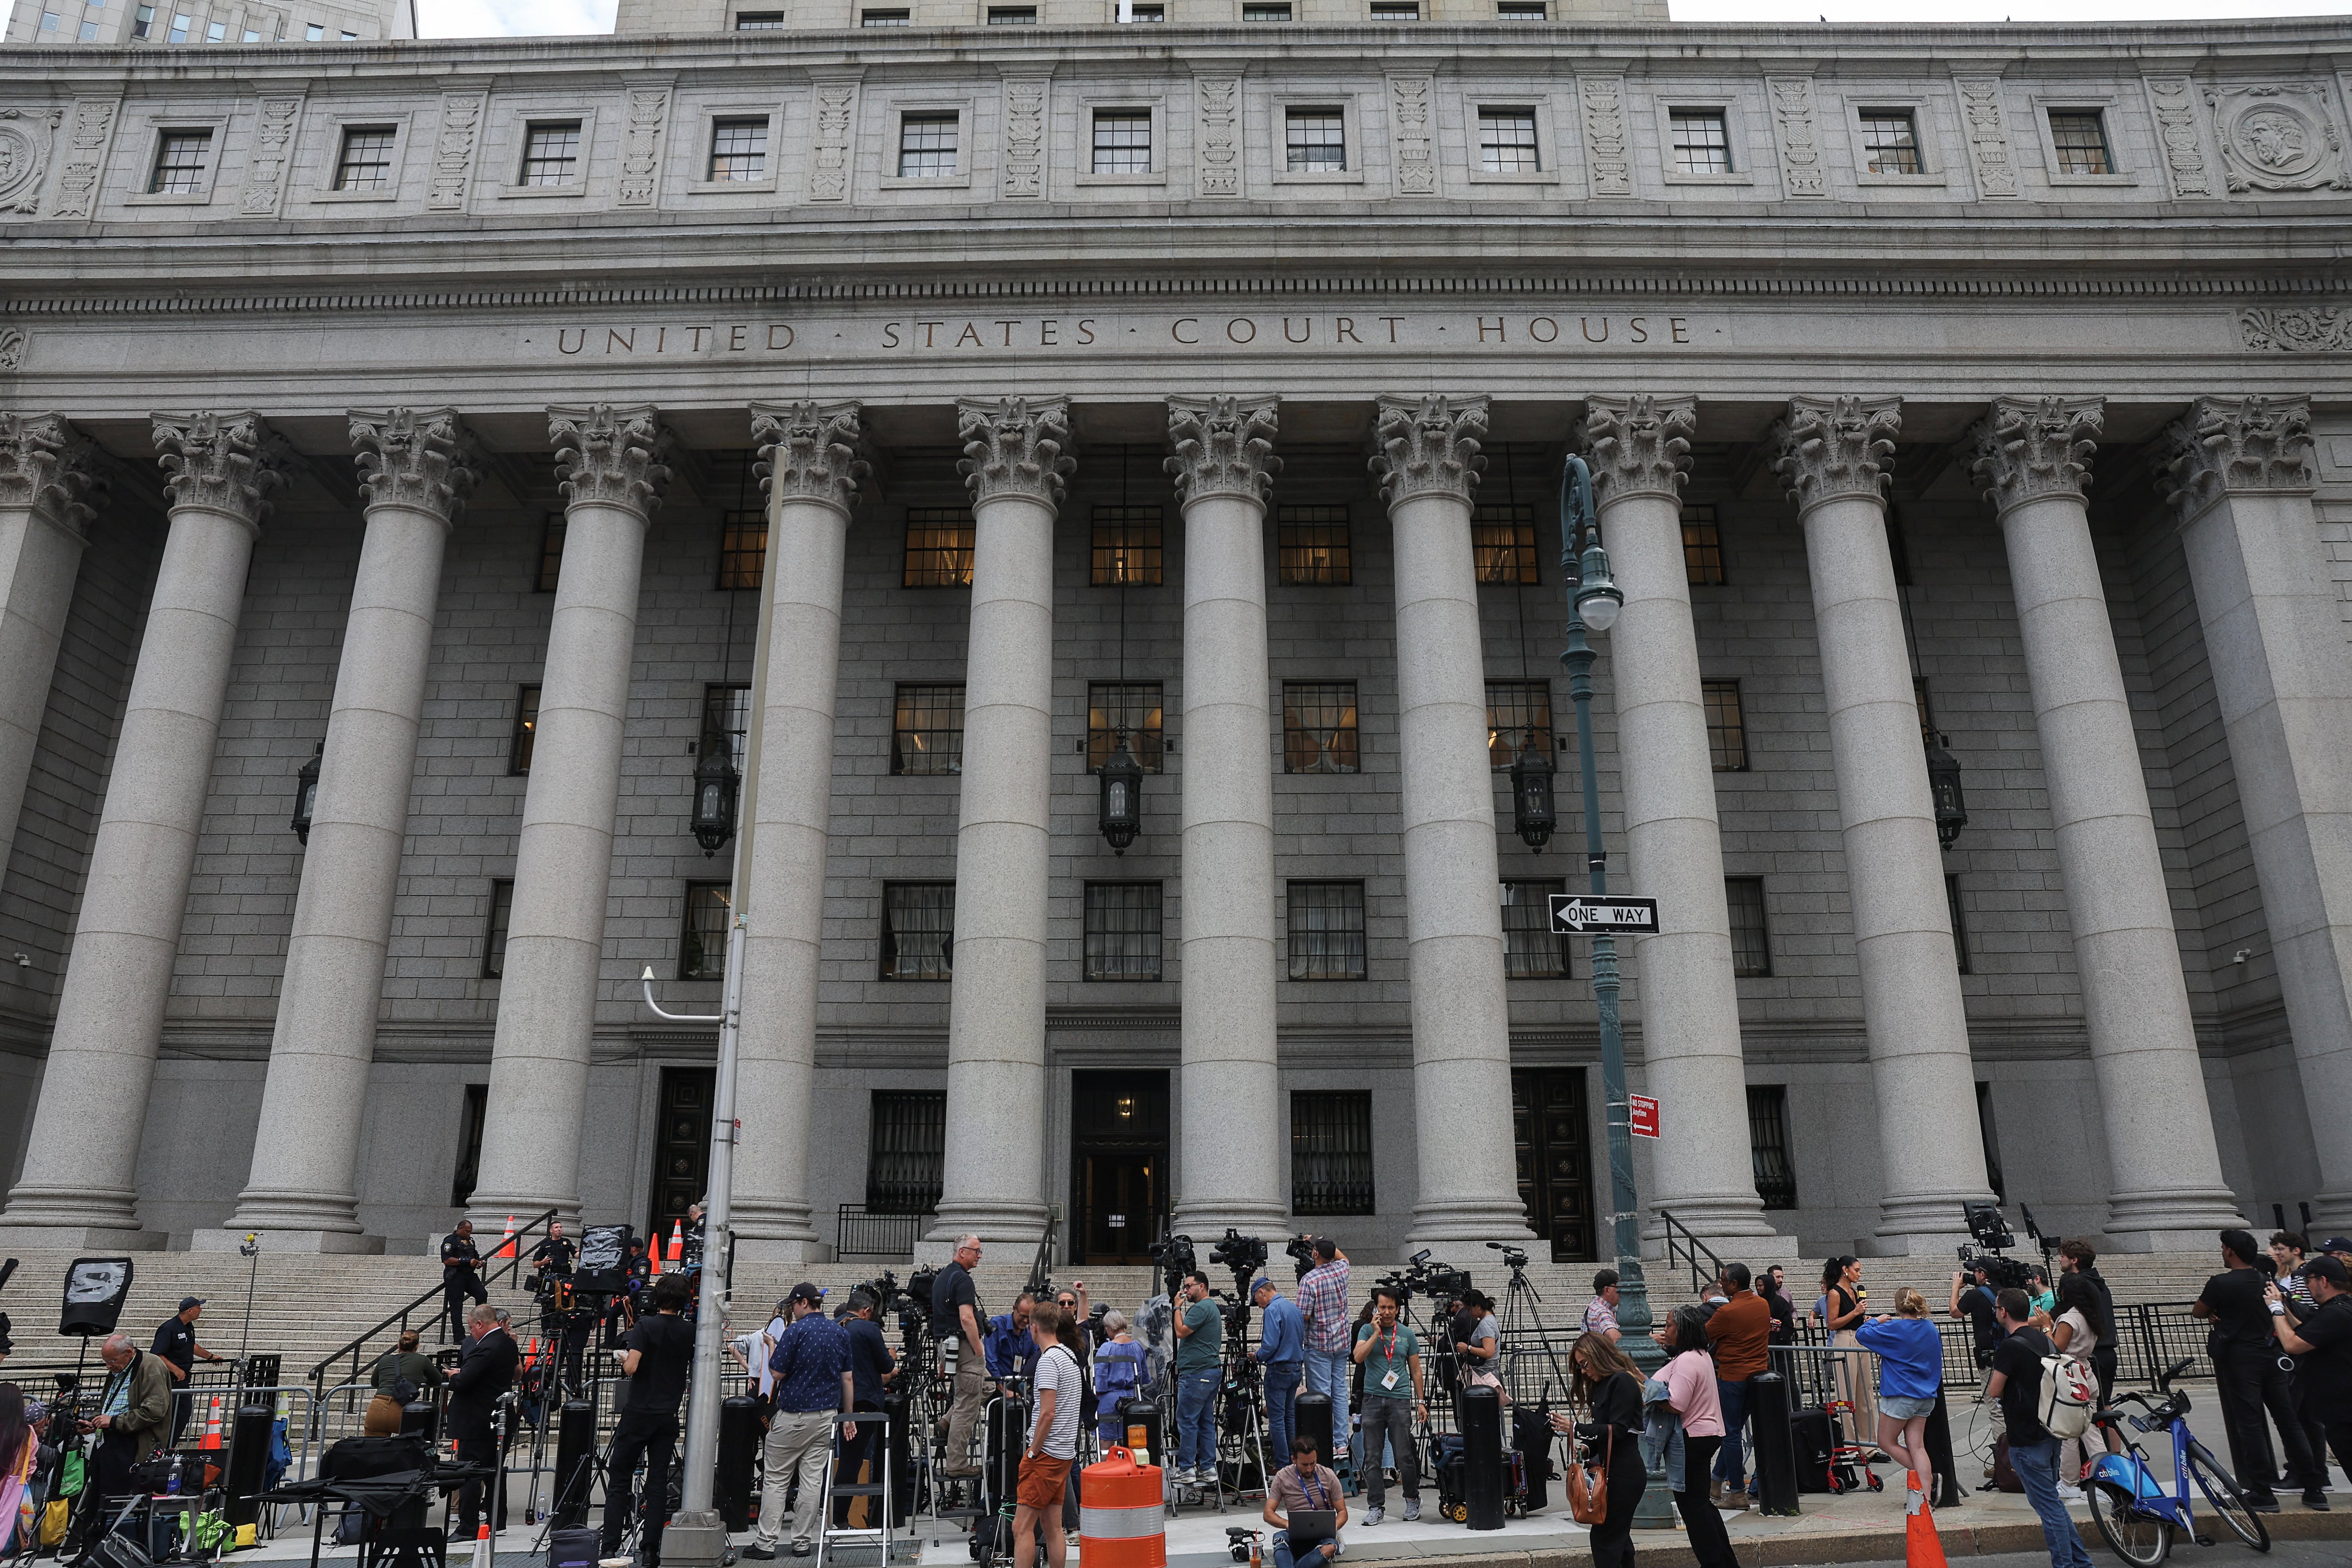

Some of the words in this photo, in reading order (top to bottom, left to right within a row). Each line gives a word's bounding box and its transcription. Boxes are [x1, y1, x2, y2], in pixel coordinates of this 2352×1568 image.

[559, 324, 795, 354] UNITED
[882, 319, 1096, 348] STATES
[1171, 317, 1406, 344] COURT
[1478, 317, 1690, 344] HOUSE
[1568, 907, 1599, 922] ONE
[1613, 908, 1644, 923] WAY
[1638, 1100, 1654, 1110] STOPPING
[1633, 1108, 1647, 1117] Anytime
